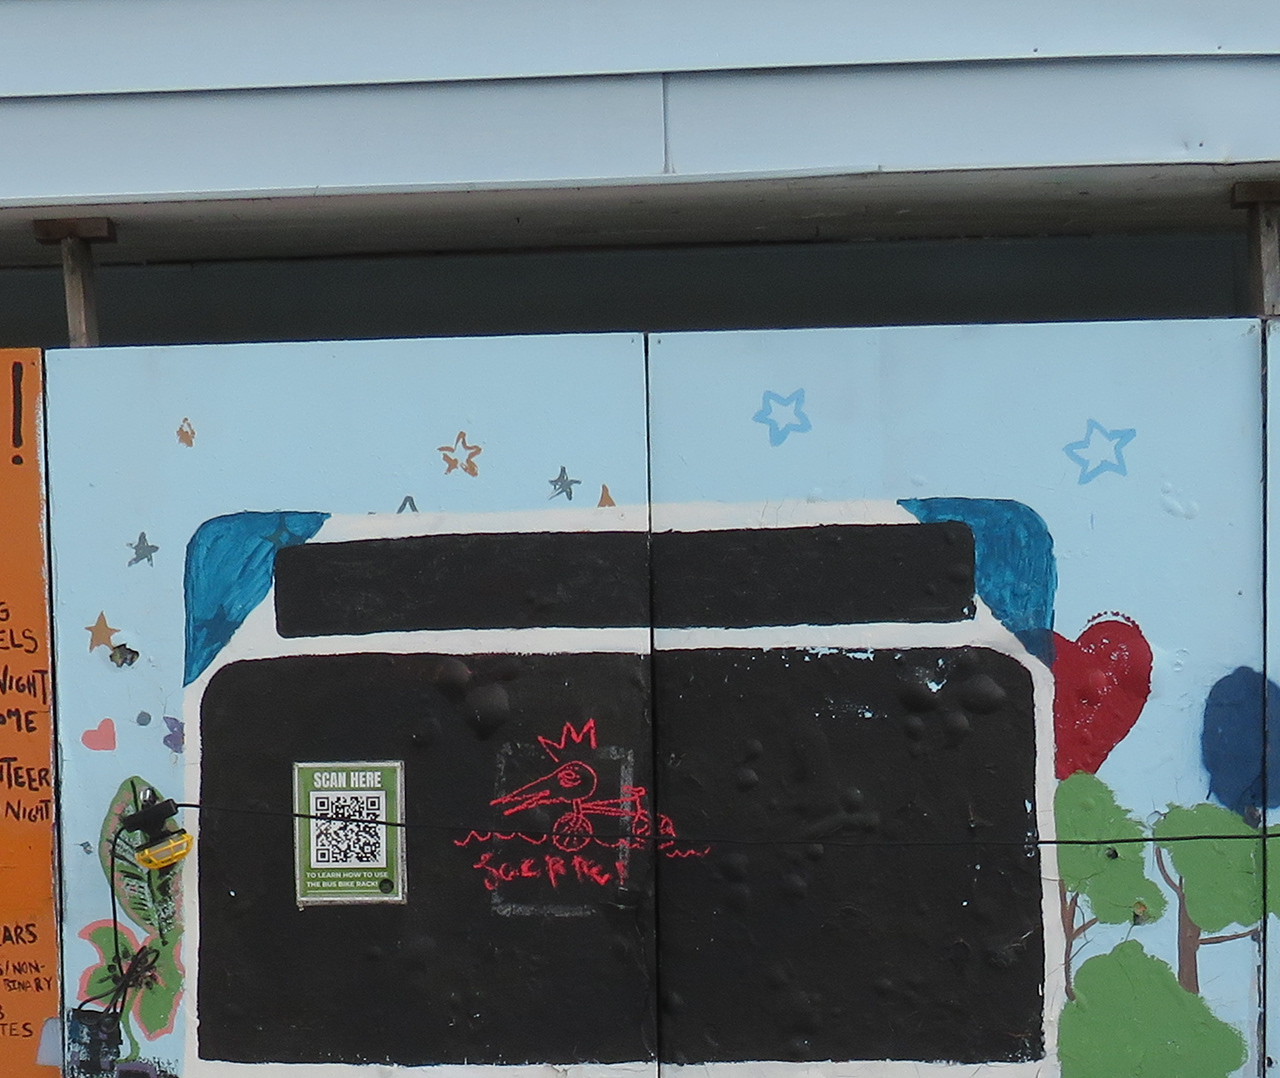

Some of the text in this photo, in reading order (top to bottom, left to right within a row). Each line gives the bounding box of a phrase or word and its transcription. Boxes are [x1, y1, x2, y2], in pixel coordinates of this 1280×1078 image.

[313, 771, 382, 788] SCAN HERE
[5, 798, 52, 823] NIGHT
